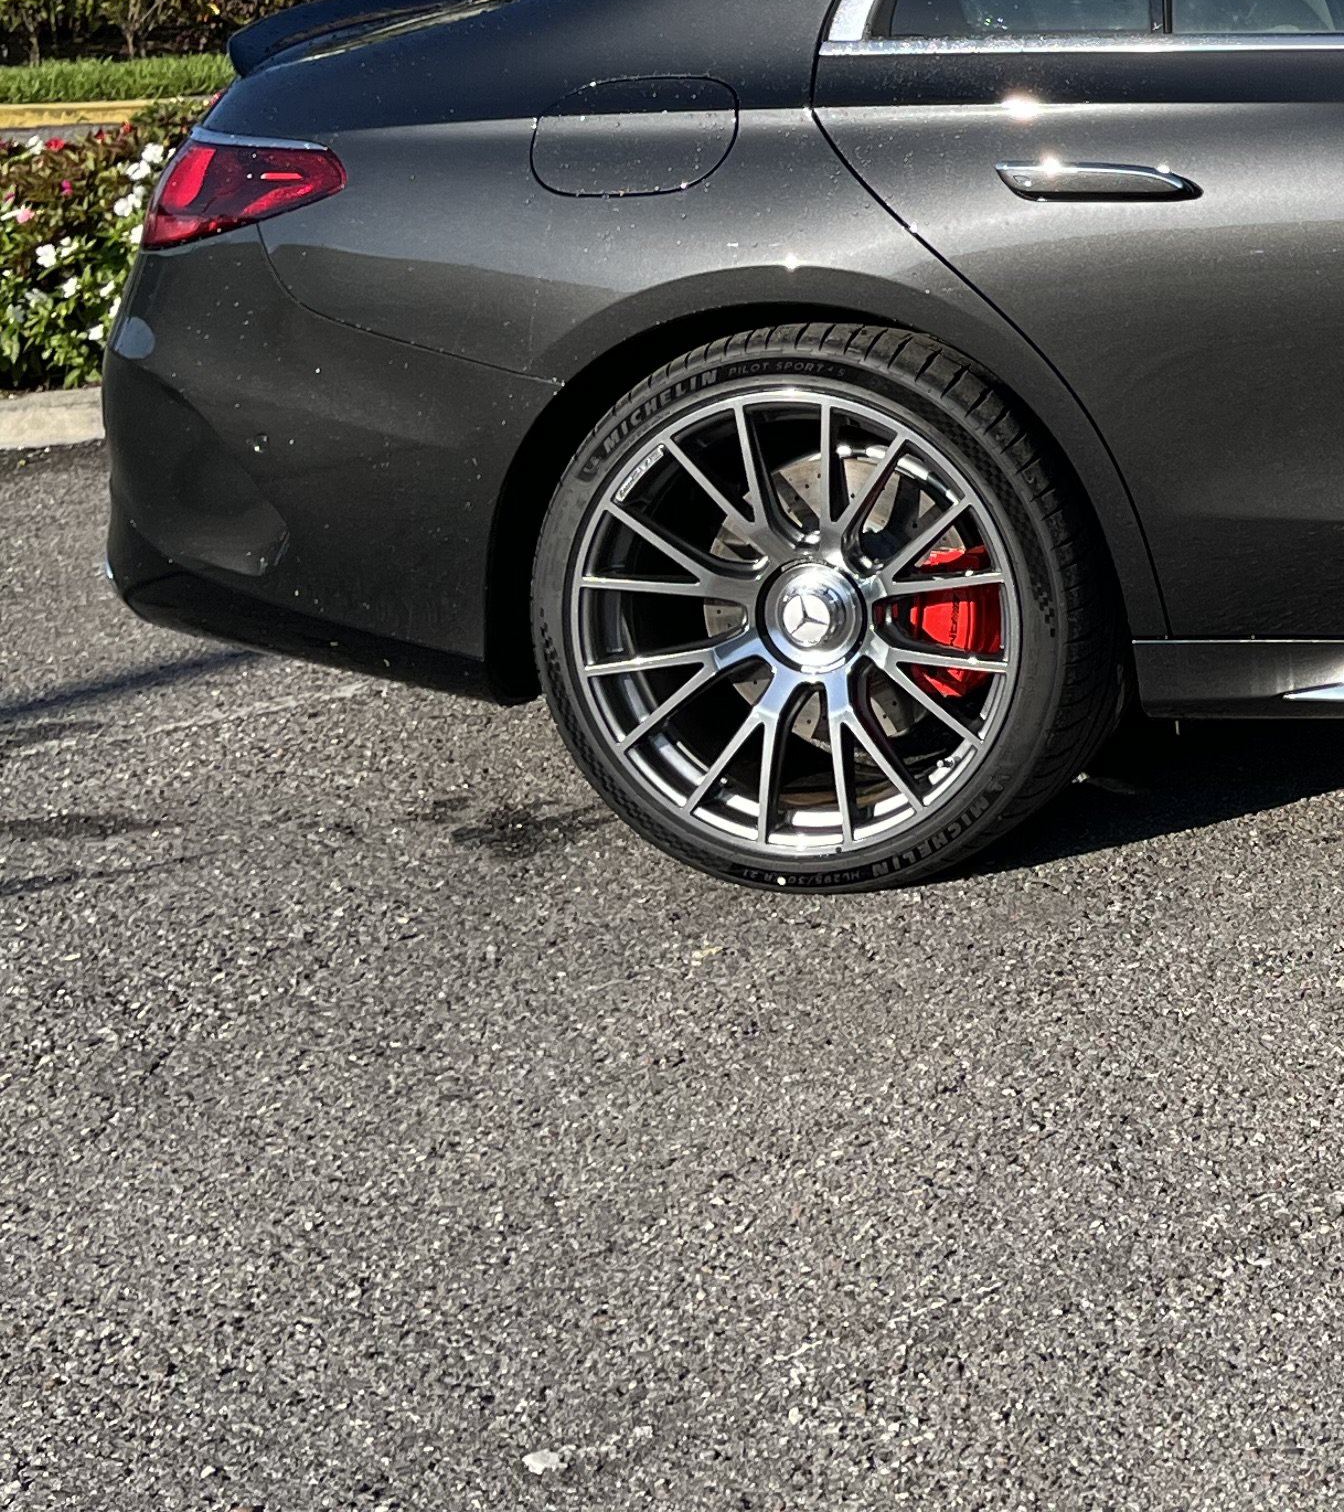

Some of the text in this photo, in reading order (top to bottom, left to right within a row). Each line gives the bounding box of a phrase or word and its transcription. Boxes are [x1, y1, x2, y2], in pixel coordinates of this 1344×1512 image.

[602, 368, 718, 454] MICHELIN
[727, 361, 770, 377] PILOT
[775, 360, 825, 373] SPORT
[871, 792, 990, 877] MICHELIN
